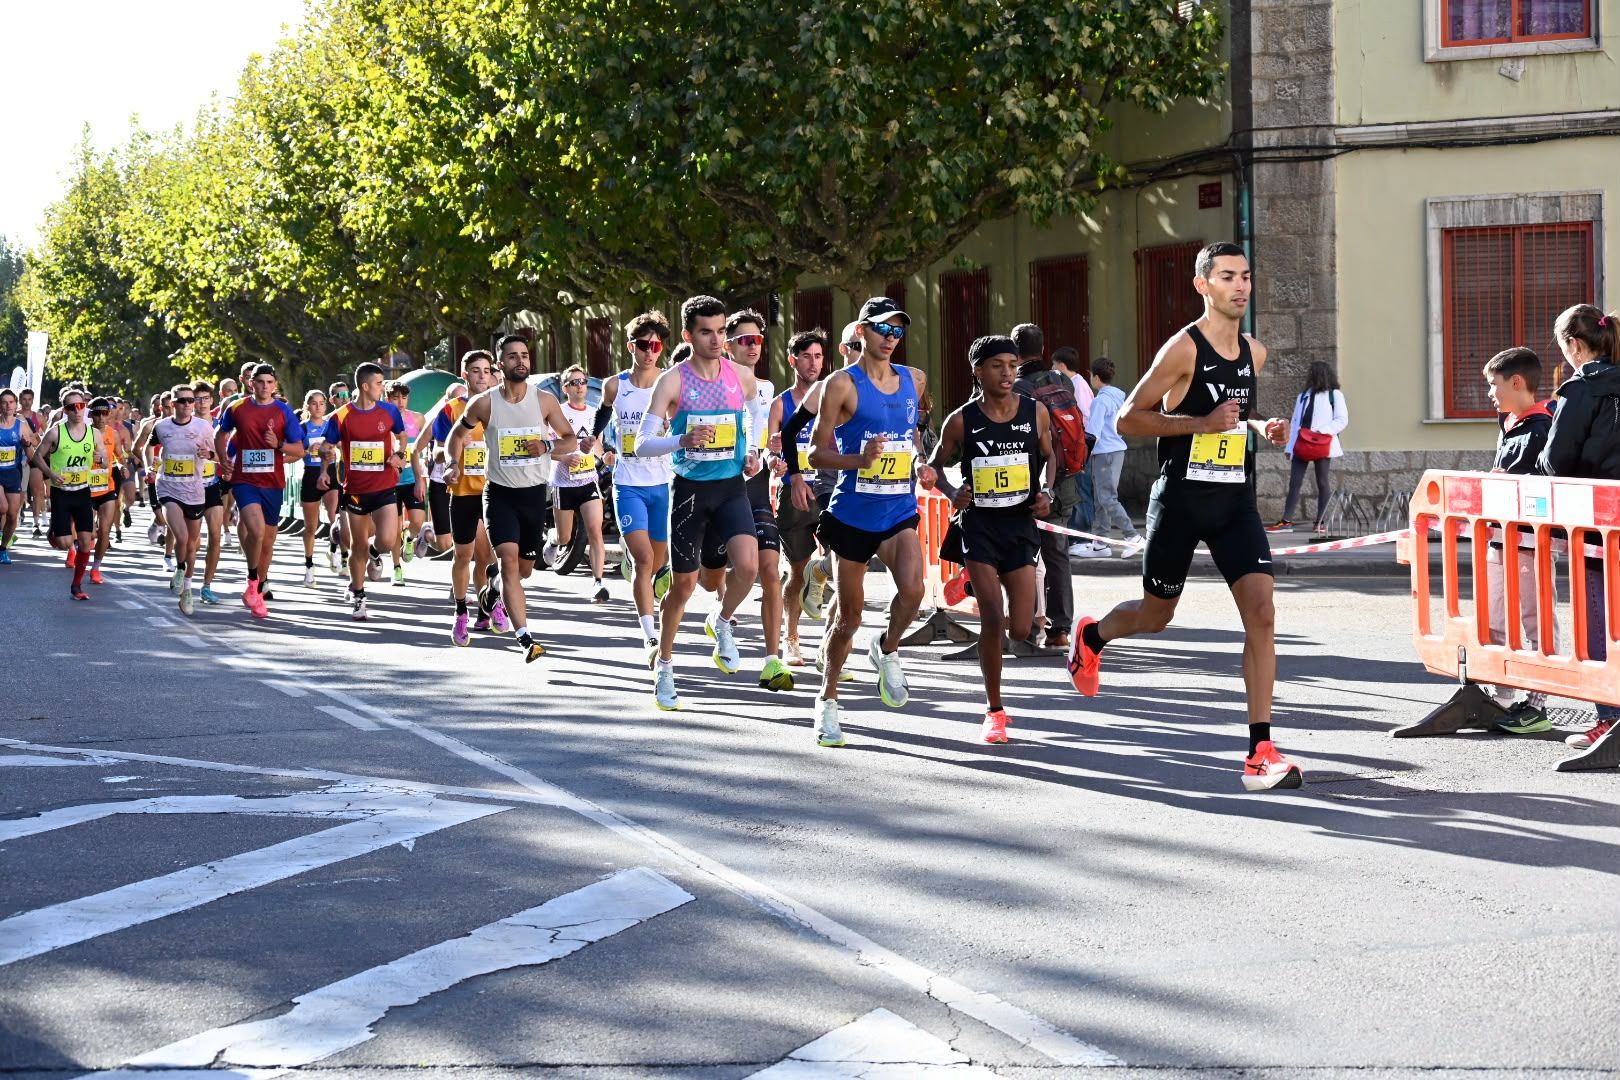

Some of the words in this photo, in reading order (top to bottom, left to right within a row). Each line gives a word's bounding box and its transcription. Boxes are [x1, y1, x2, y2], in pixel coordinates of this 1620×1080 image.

[1226, 388, 1249, 397] VICKY
[996, 441, 1025, 450] VICKY
[1217, 439, 1228, 459] 6
[249, 451, 266, 462] 336
[361, 450, 373, 461] 48
[172, 462, 184, 473] 45
[880, 457, 896, 475] 72
[70, 474, 80, 483] 26
[91, 475, 100, 484] 119
[994, 470, 1009, 489] 15
